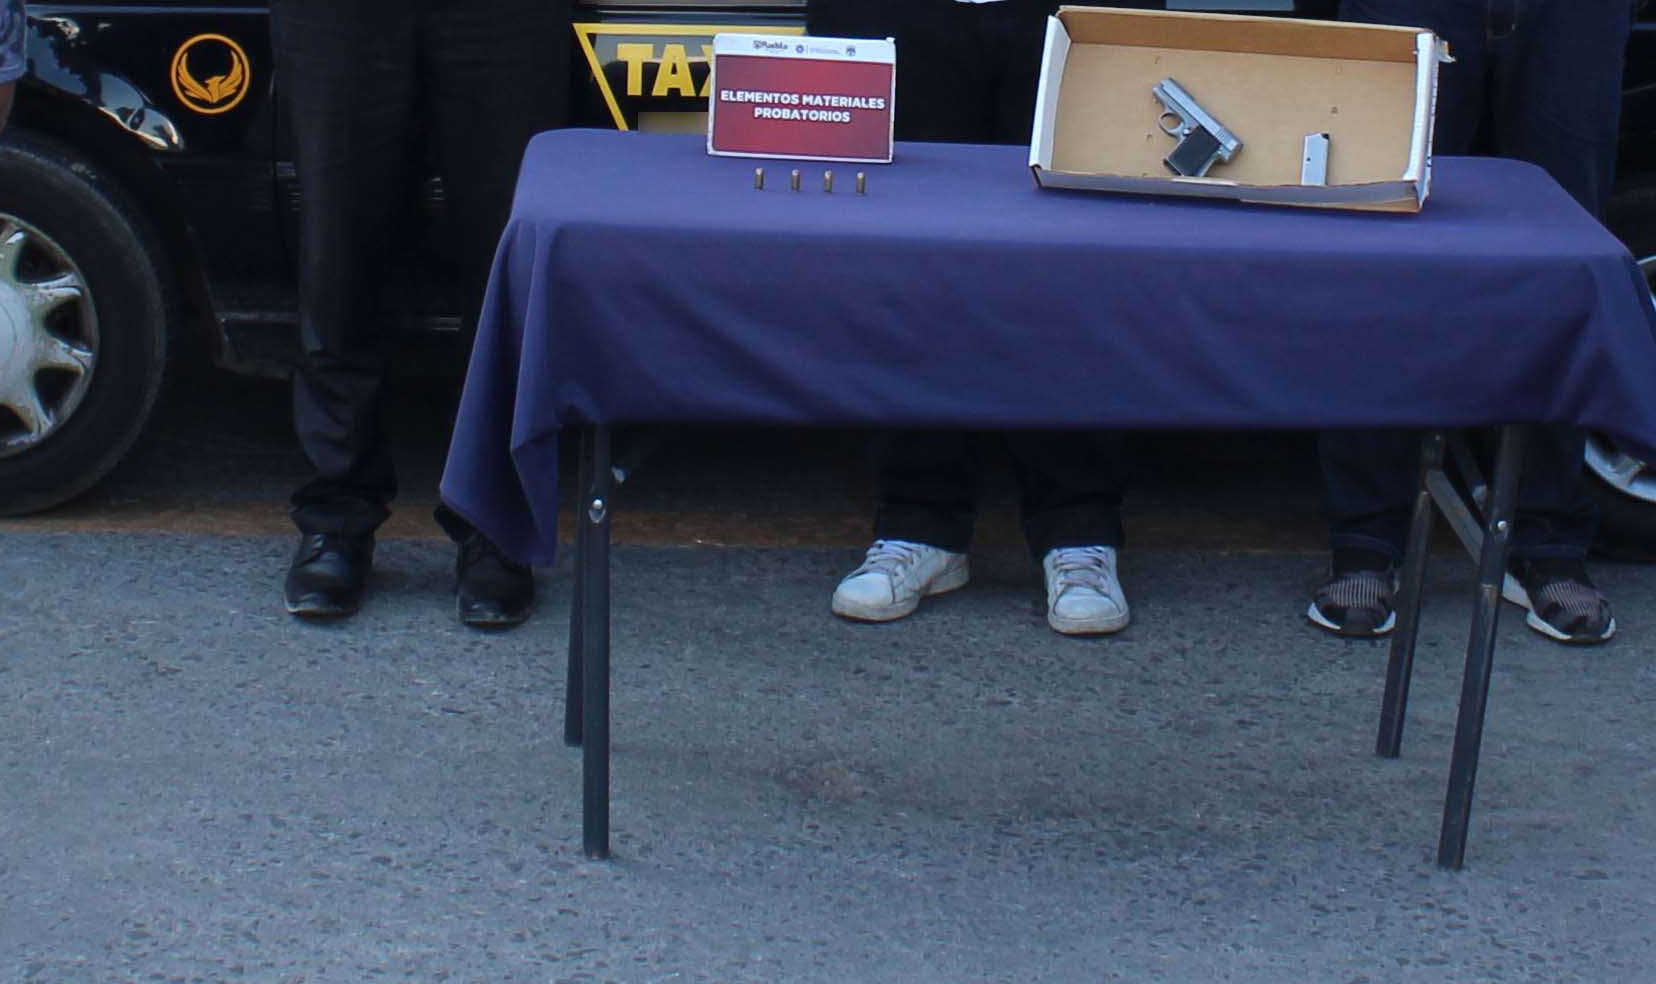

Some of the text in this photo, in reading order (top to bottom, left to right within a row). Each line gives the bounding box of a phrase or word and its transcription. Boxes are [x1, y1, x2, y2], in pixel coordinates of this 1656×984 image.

[721, 90, 885, 110] ELEMENTOS MATERIALES
[754, 107, 851, 123] PROBATORIOS
